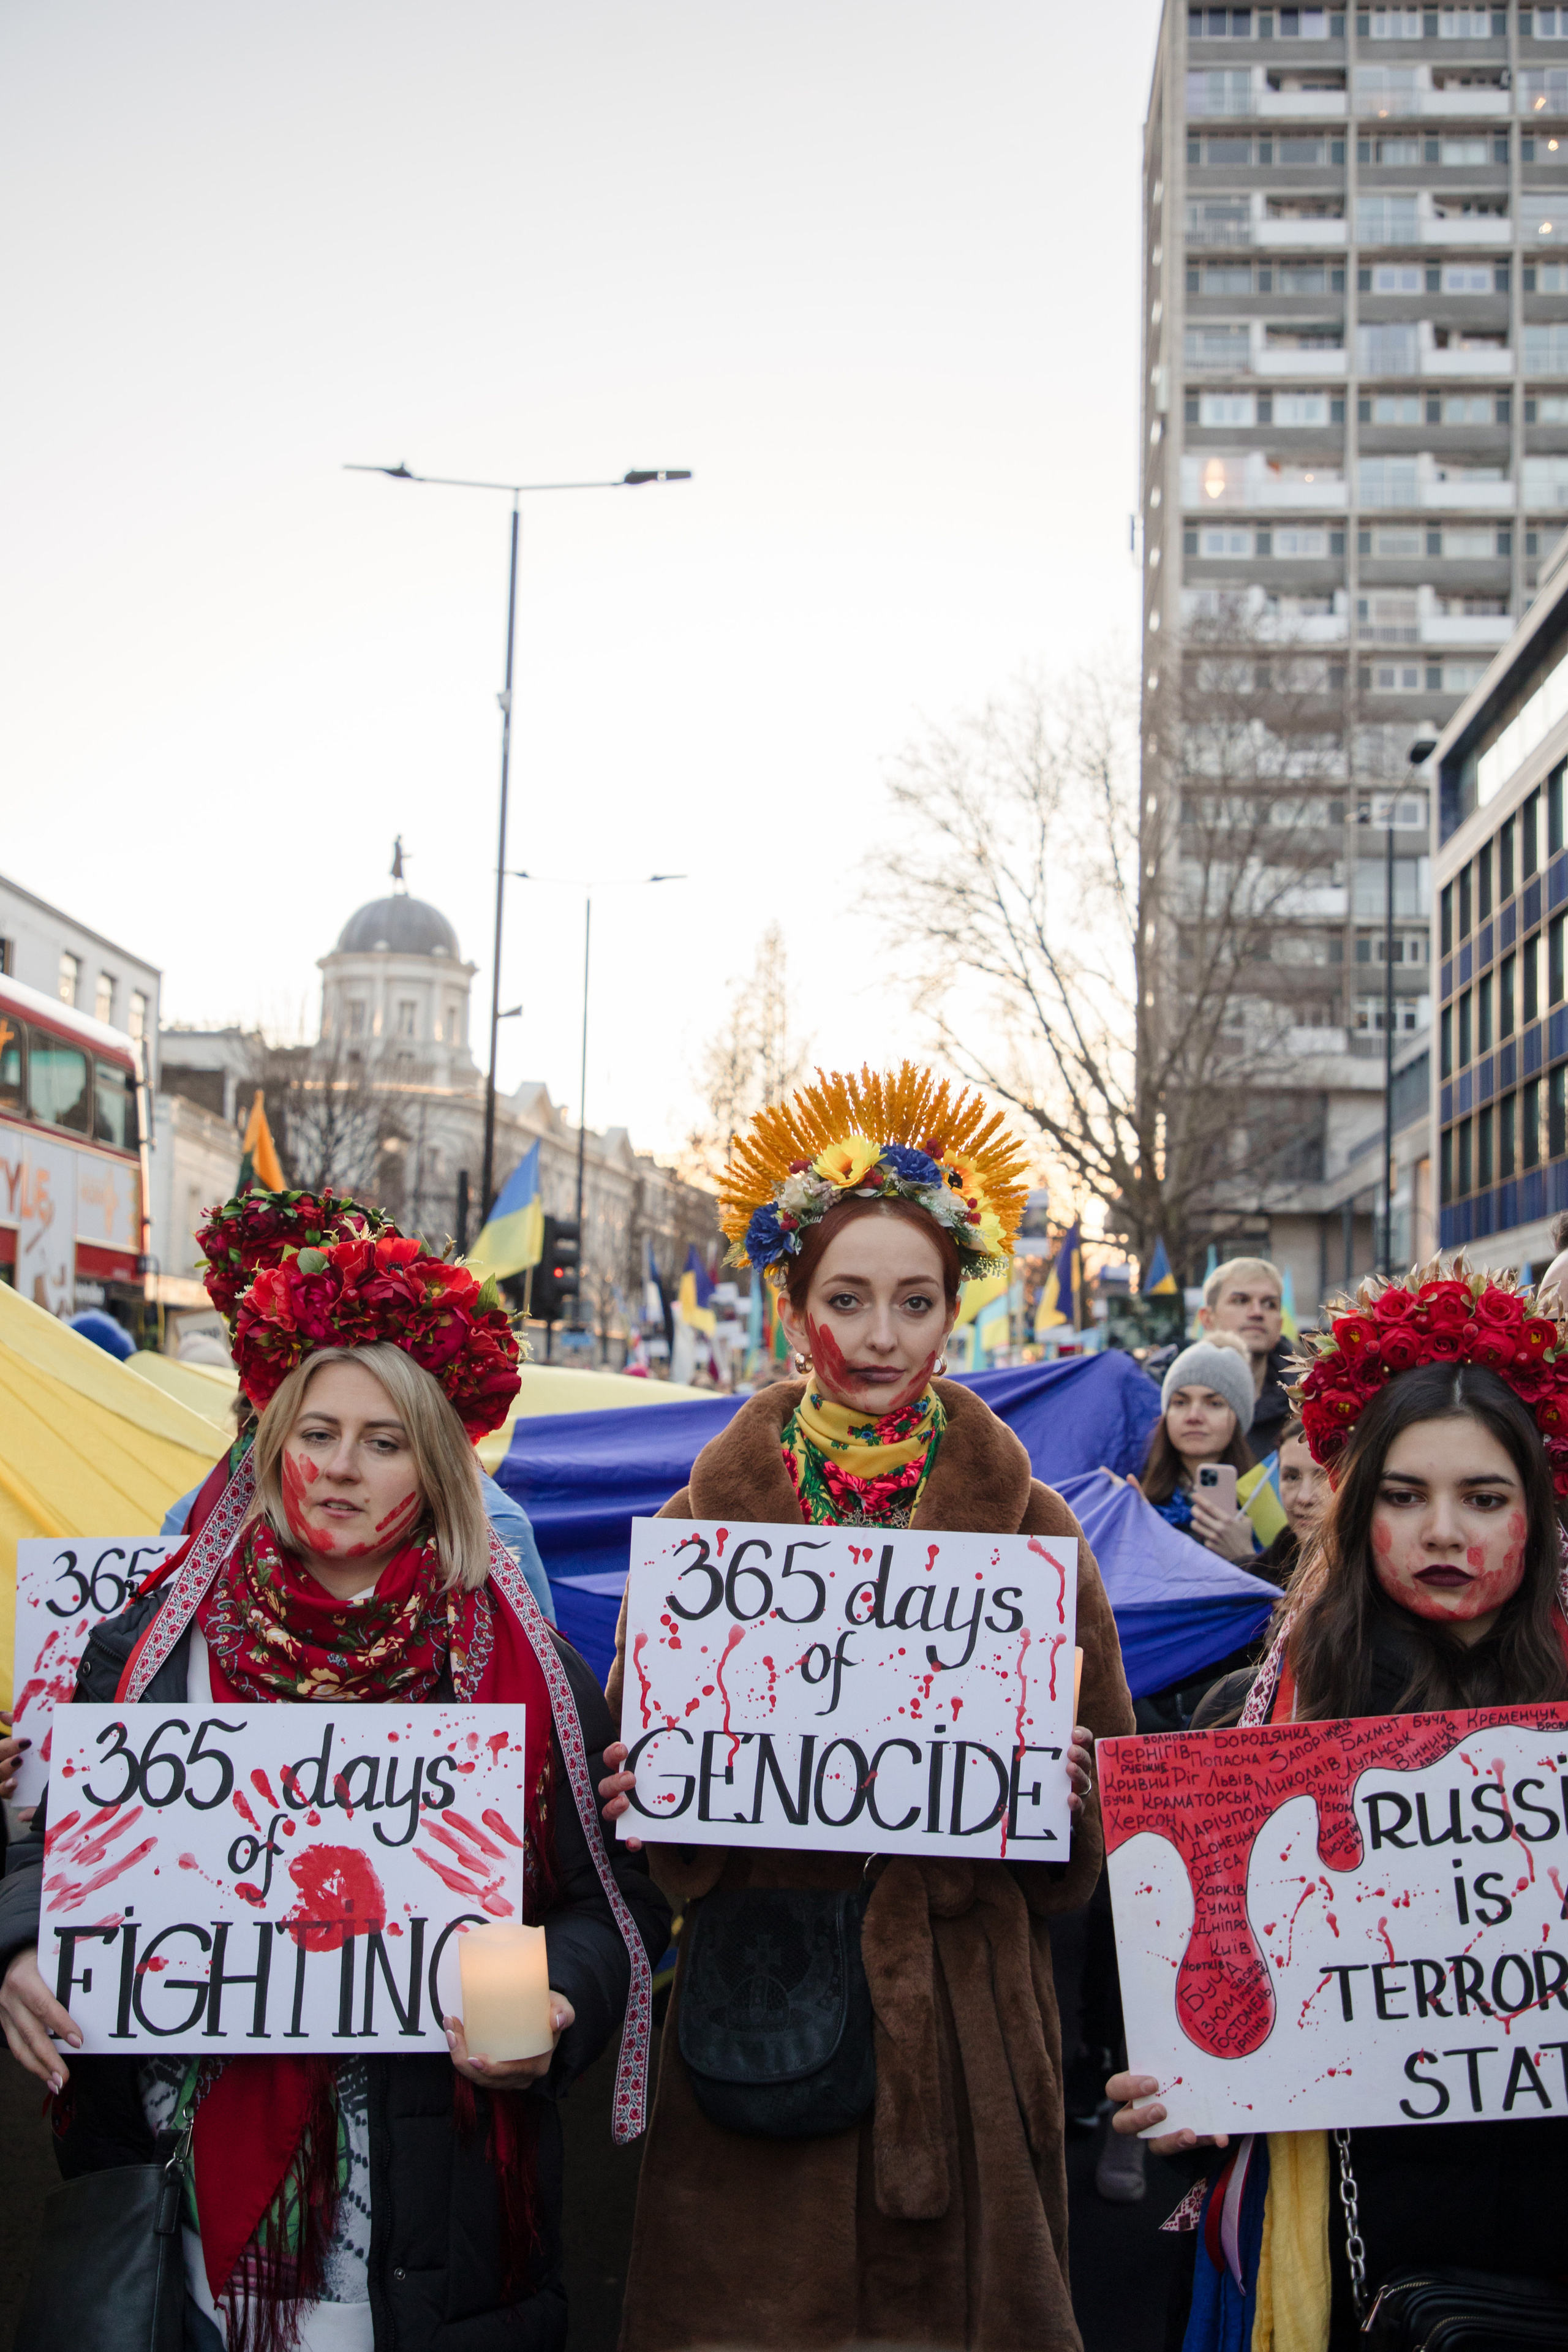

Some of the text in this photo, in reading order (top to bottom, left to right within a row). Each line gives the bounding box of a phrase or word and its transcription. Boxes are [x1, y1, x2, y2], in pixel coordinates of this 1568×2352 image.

[666, 1537, 1023, 1670] 365 days
[800, 1631, 861, 1716] of
[82, 1718, 456, 1847] 365 days
[624, 1724, 1062, 1840] GENOCIDE
[228, 1814, 288, 1901] of
[1452, 1858, 1513, 1925] is
[1319, 1950, 1568, 2022] TERROR
